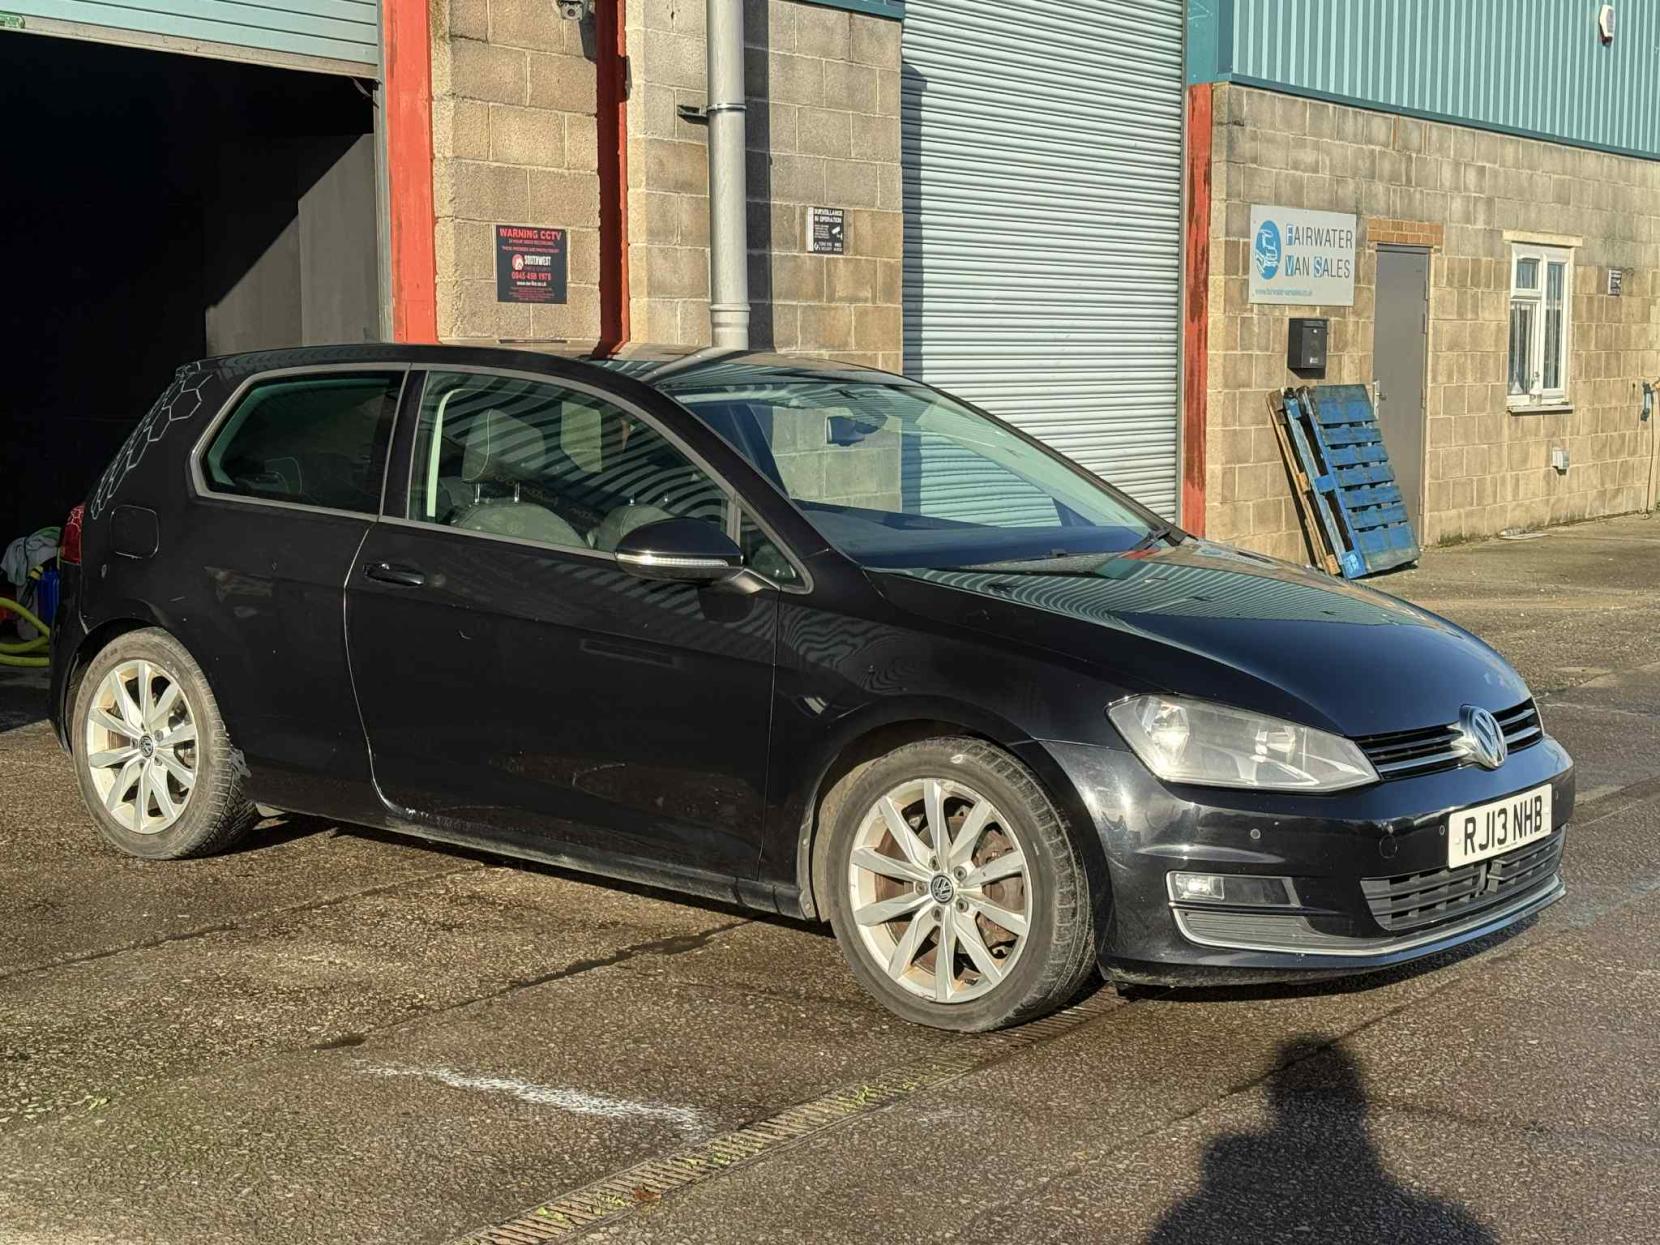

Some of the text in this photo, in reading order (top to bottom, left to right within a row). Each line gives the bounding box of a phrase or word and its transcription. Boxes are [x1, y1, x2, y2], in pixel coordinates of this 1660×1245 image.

[499, 228, 562, 240] WARNING CCTV
[1286, 224, 1353, 249] FAIRWATER
[1285, 255, 1351, 279] VAN SALES
[1464, 795, 1543, 856] RJ13 NHB
